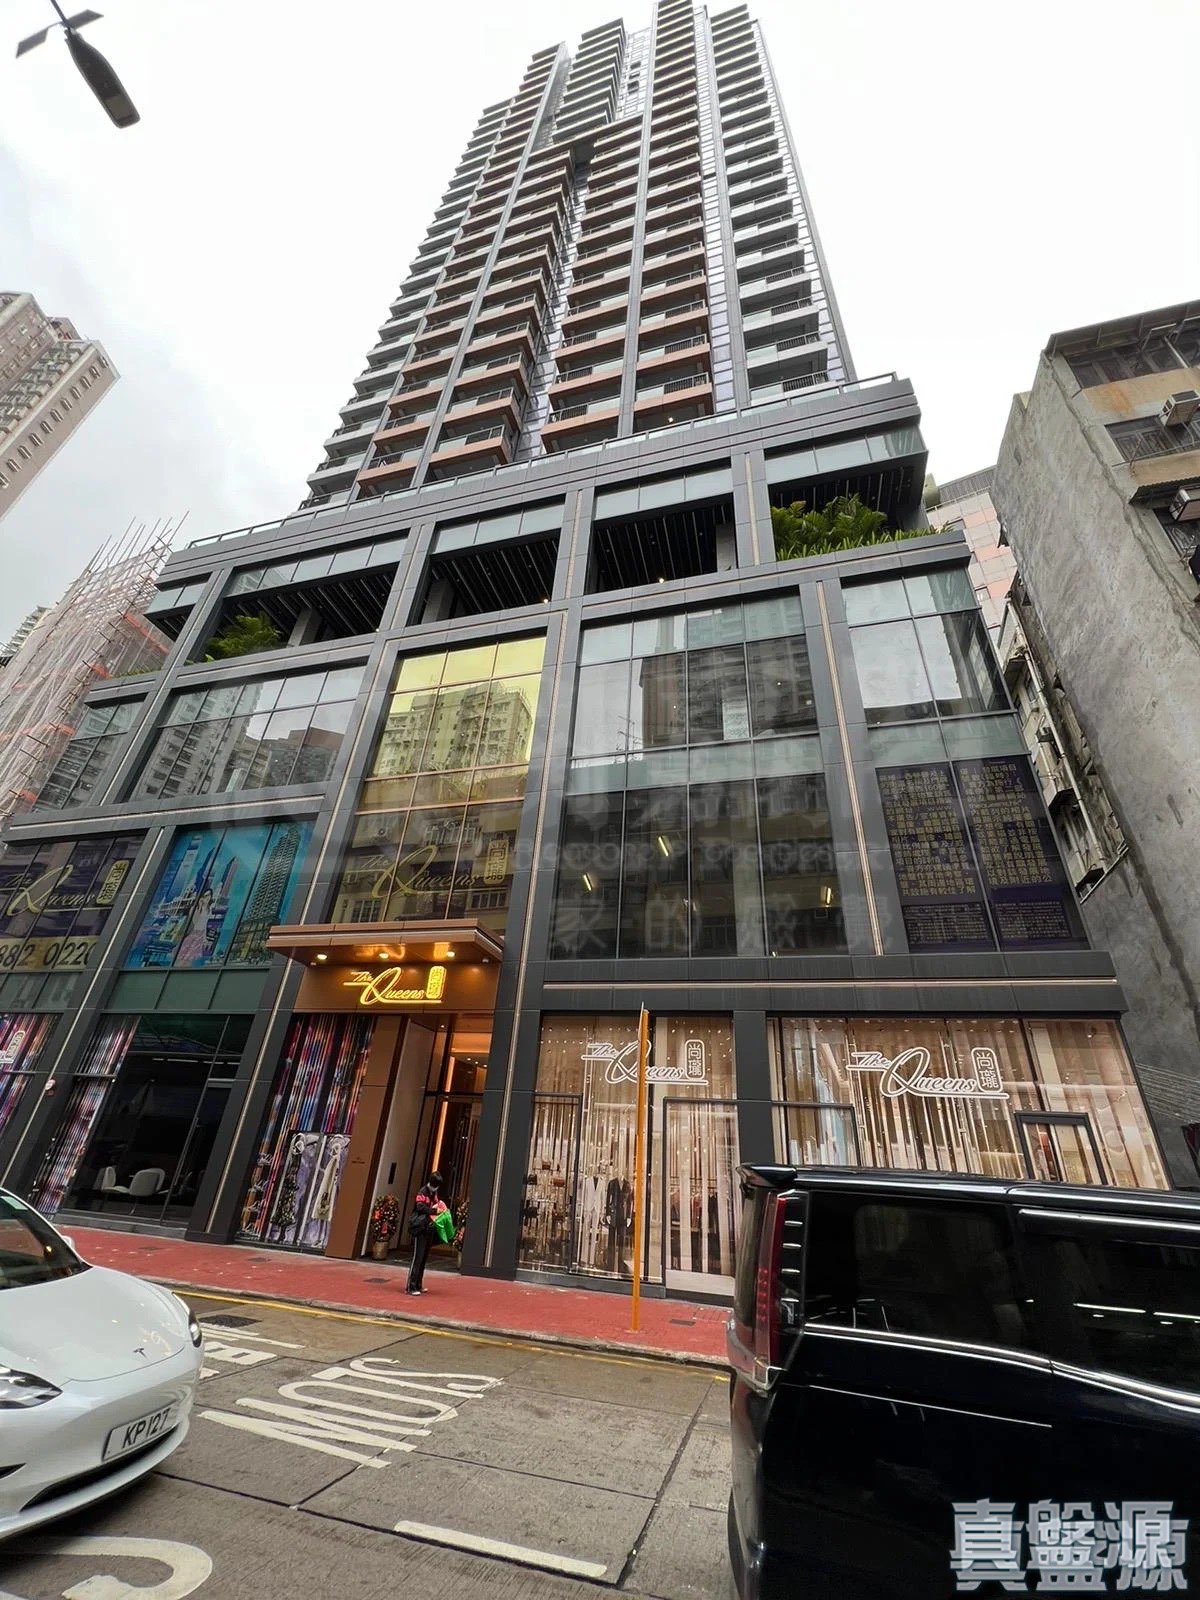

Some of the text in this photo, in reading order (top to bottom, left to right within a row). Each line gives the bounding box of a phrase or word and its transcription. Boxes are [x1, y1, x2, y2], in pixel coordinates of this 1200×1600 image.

[372, 845, 495, 897] Queens
[360, 966, 436, 1005] Queens
[587, 1043, 620, 1058] The
[851, 1052, 892, 1067] The
[881, 1047, 988, 1098] Queens
[122, 1407, 171, 1449] KP127
[197, 1358, 506, 1469] SLOW
